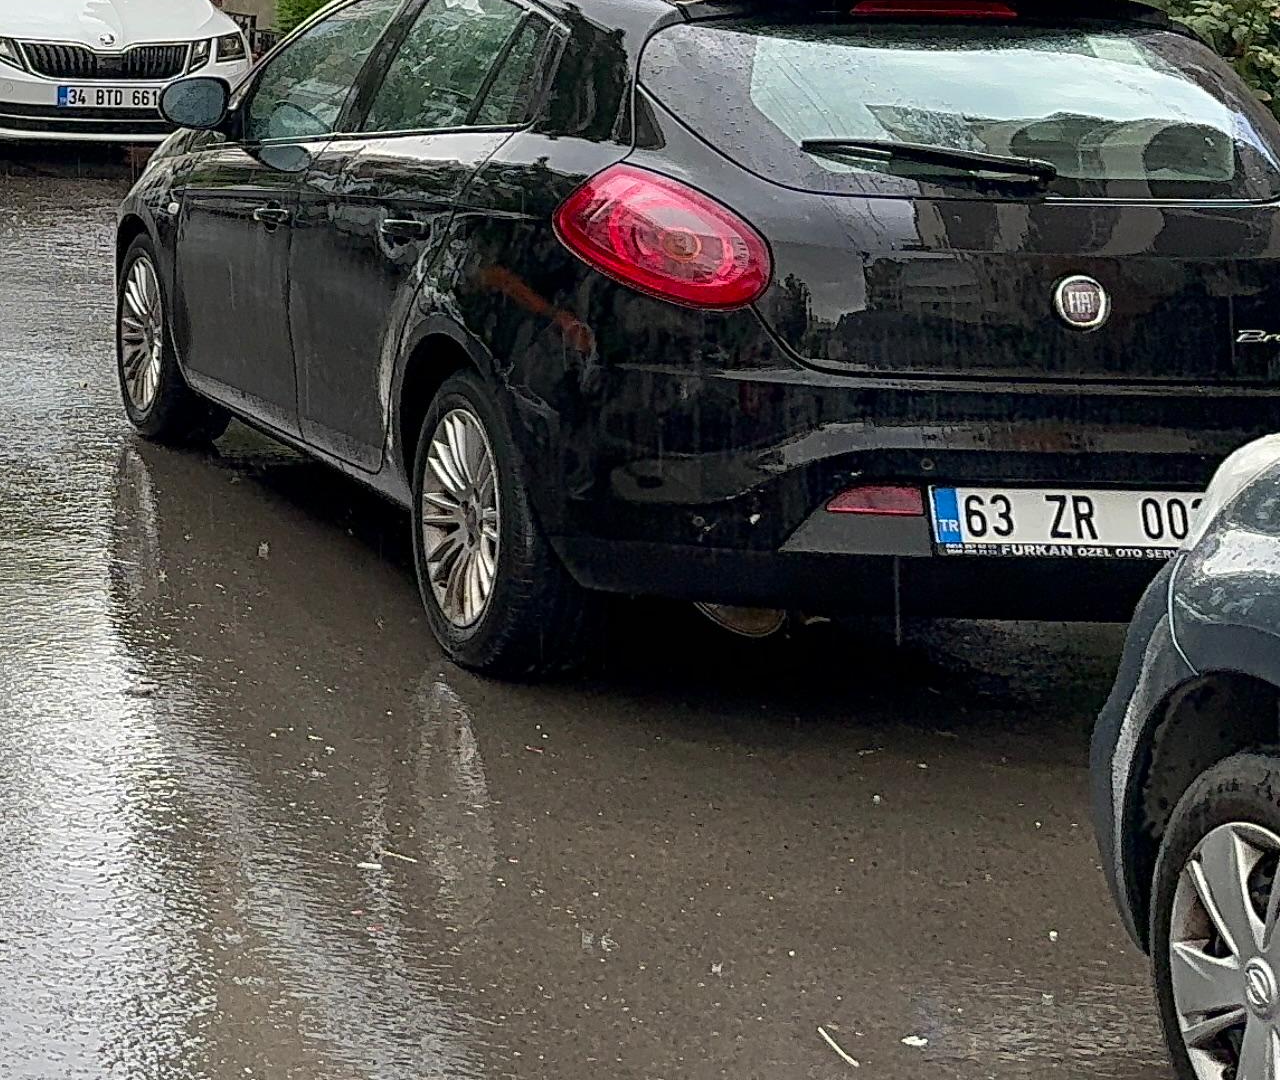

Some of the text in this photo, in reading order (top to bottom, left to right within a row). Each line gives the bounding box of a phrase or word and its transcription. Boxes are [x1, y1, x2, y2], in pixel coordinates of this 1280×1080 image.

[68, 89, 86, 105] 34
[96, 90, 123, 106] BTD
[1068, 291, 1095, 314] FIAT
[939, 519, 959, 533] TR
[965, 494, 1015, 537] 63
[1045, 494, 1098, 540] ZR
[1001, 544, 1073, 557] FURKAN
[1115, 548, 1142, 558] OTO
